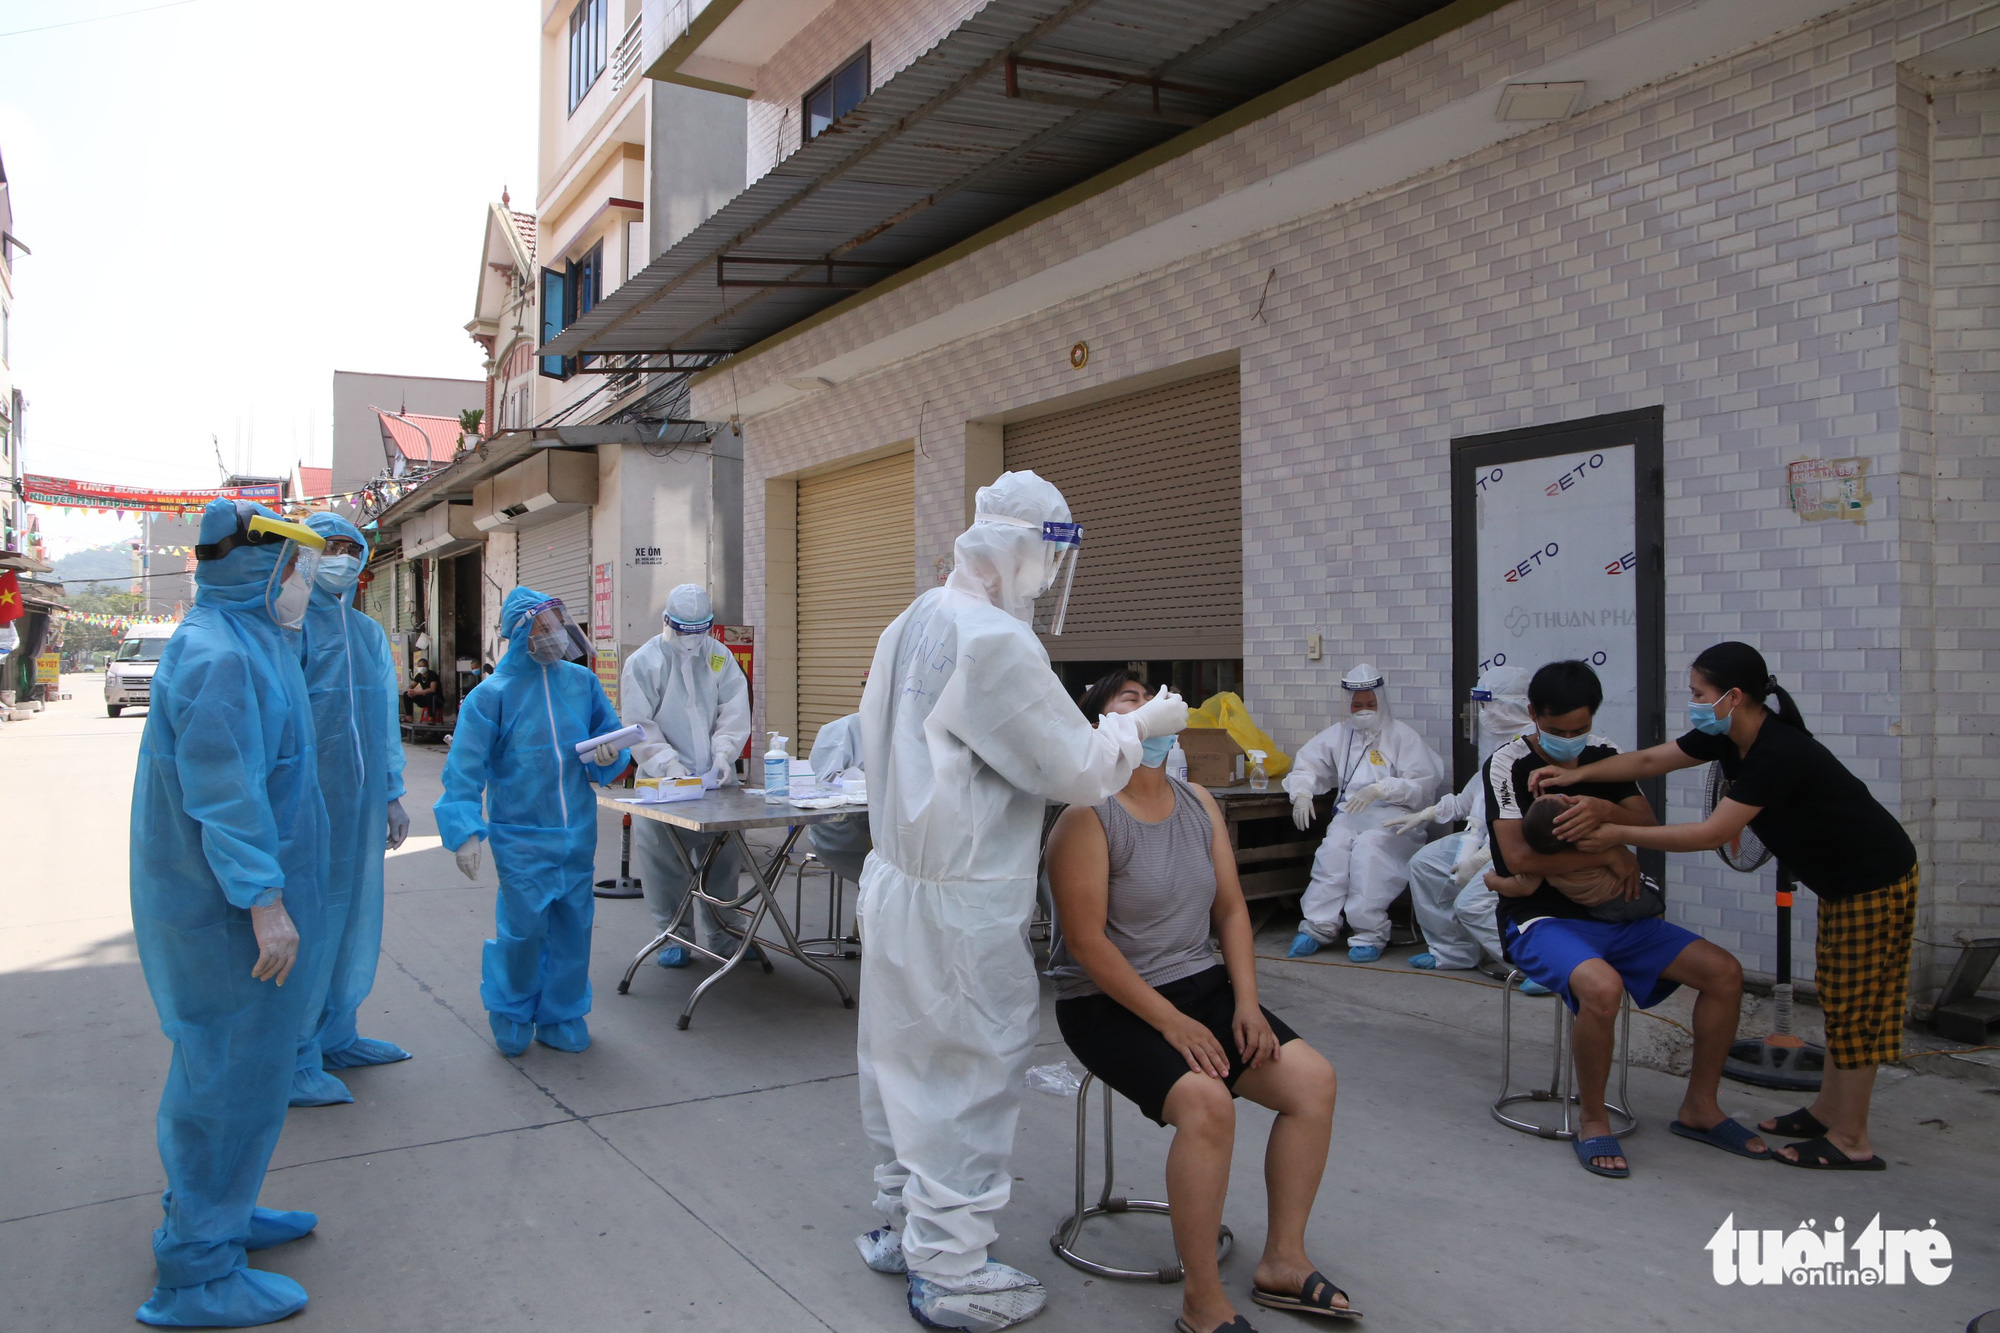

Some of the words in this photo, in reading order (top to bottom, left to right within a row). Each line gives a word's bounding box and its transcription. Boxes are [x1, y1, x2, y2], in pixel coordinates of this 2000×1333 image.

[1476, 468, 1503, 491] TO
[635, 547, 646, 557] XE
[648, 546, 661, 557] ÔM
[1605, 551, 1637, 575] RE
[1600, 608, 1637, 627] PHA
[1479, 653, 1507, 672] TO
